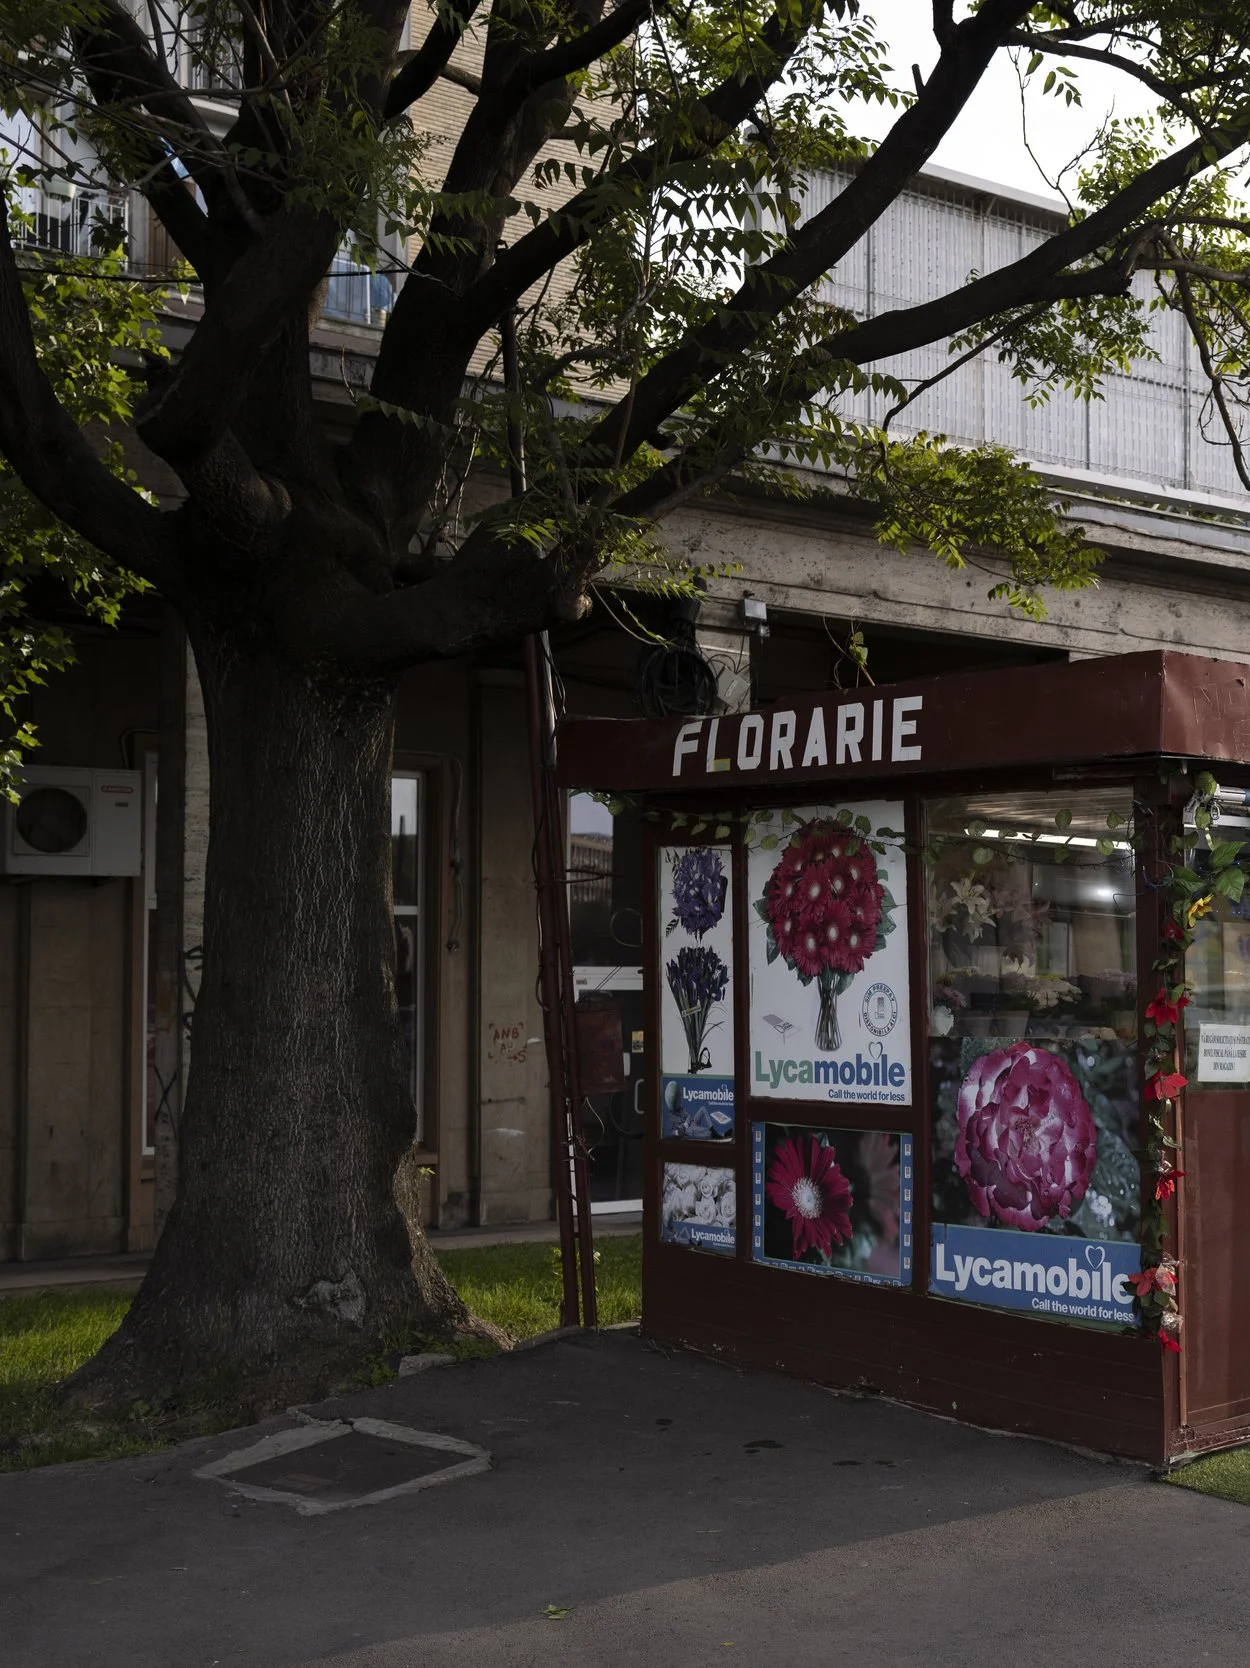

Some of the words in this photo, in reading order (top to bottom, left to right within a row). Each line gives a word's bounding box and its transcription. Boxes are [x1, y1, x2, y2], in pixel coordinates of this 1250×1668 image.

[672, 694, 923, 777] FLORARIE
[755, 1050, 906, 1090] Lycamobile
[682, 1087, 735, 1102] Lycamobile
[828, 1088, 843, 1099] Call
[843, 1089, 856, 1100] the
[856, 1090, 878, 1100] world
[878, 1091, 890, 1101] for
[890, 1092, 905, 1102] less
[690, 1227, 736, 1244] Lycamobile
[935, 1243, 1136, 1305] Lycamobile
[1031, 1297, 1051, 1311] Call
[1051, 1300, 1068, 1313] the
[1068, 1303, 1097, 1318] world
[1097, 1306, 1113, 1320] for
[1113, 1308, 1135, 1323] less
